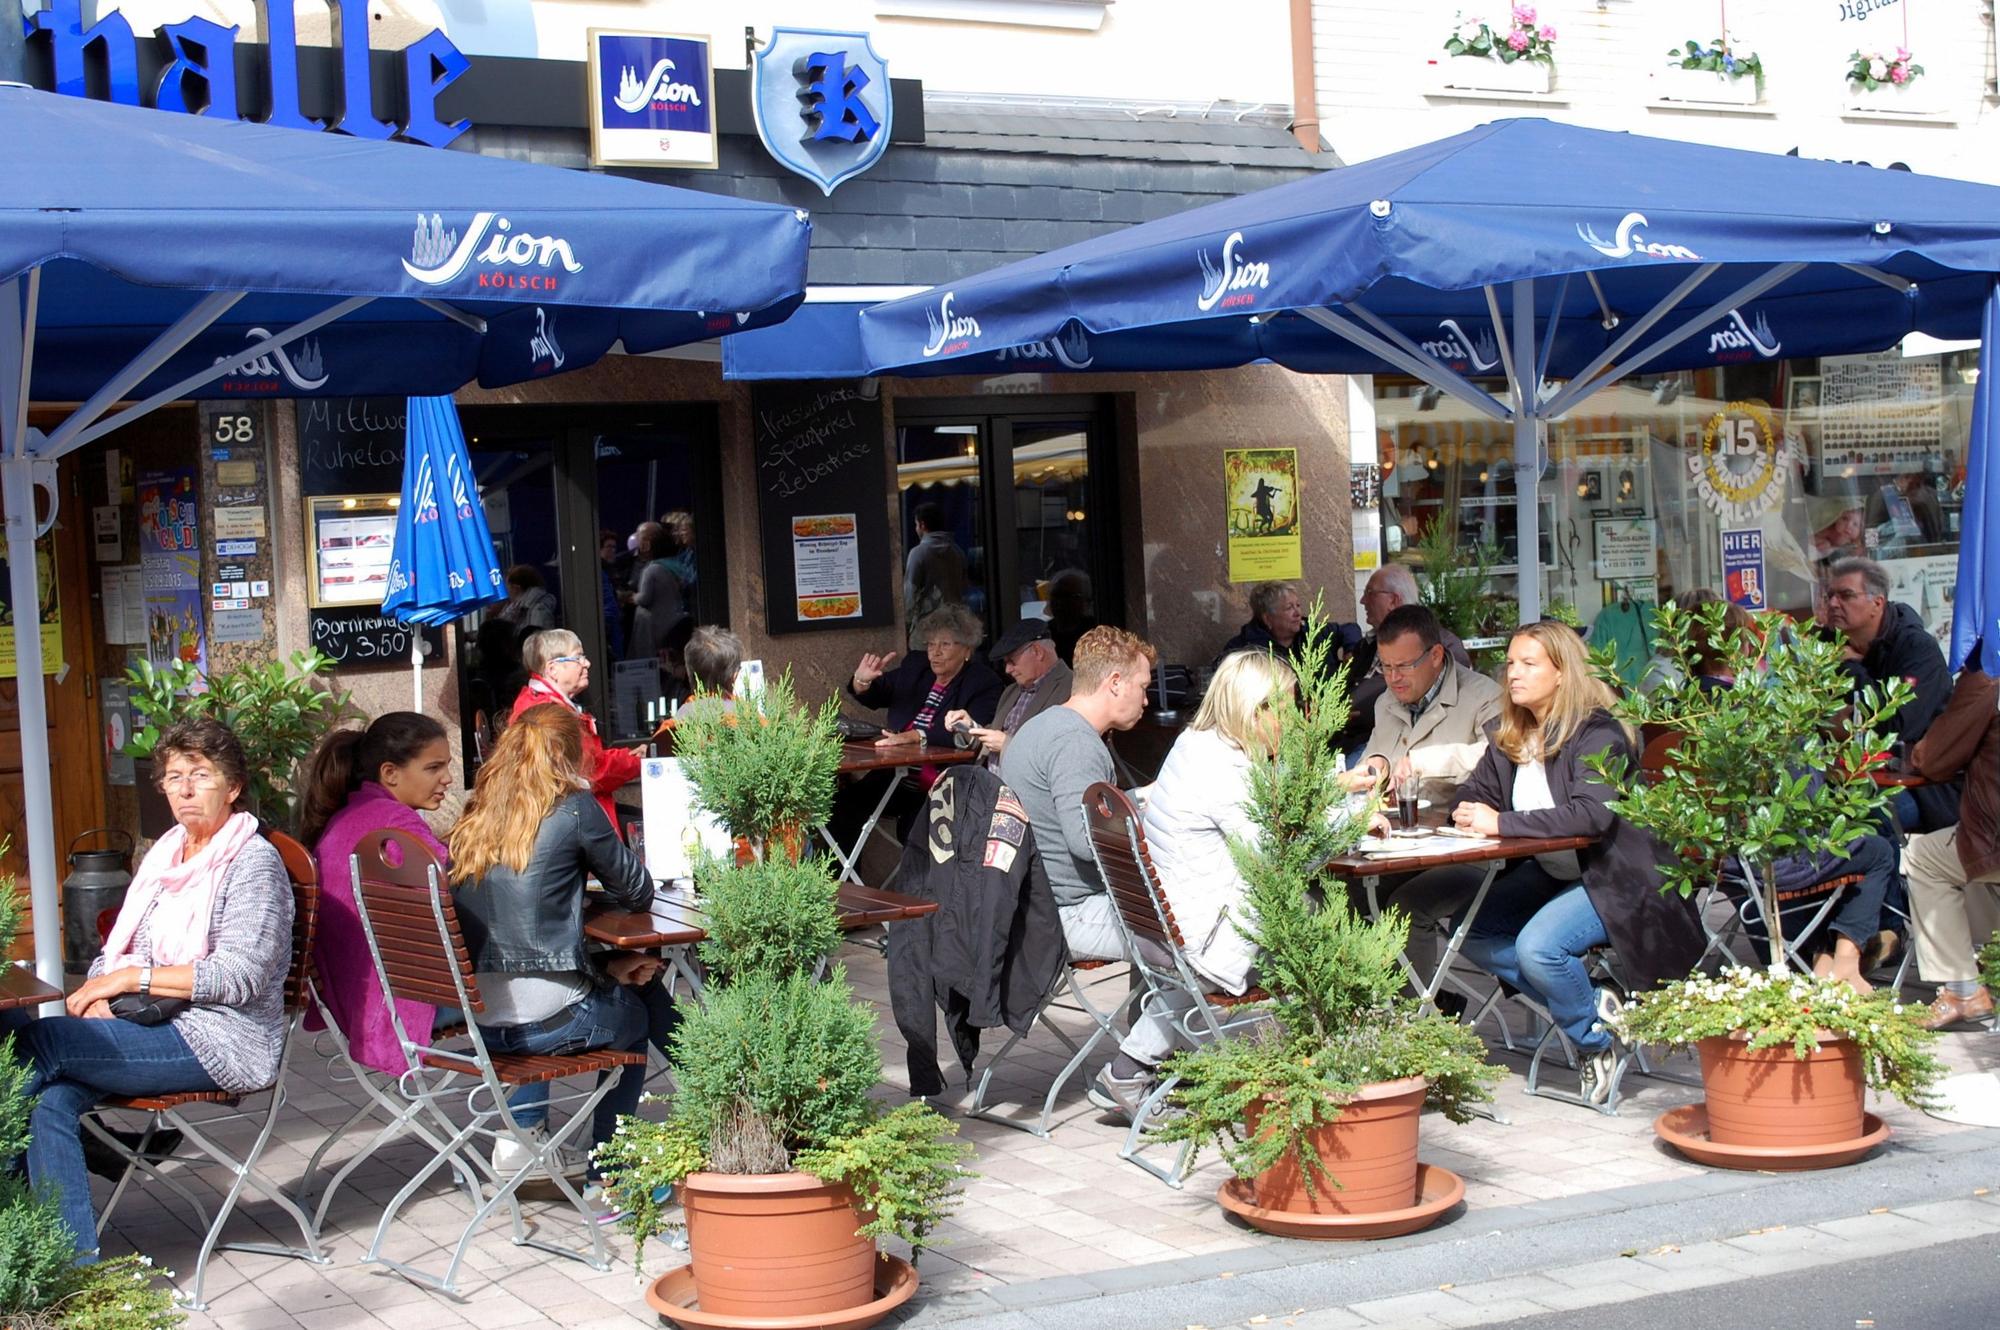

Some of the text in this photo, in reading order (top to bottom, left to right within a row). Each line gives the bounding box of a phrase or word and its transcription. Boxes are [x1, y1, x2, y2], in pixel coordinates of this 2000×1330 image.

[613, 58, 702, 114] Sion
[401, 212, 583, 286] Sion
[1590, 212, 1704, 260] Sion
[479, 272, 557, 290] KÖLSCH
[1198, 231, 1270, 312] Sion
[922, 291, 982, 357] Sion
[215, 416, 254, 443] 58
[1718, 419, 1757, 456] 15
[306, 440, 405, 472] Ruheta
[160, 521, 199, 550] GAUDI
[1724, 534, 1761, 550] HIER
[356, 633, 406, 657] 3,50
